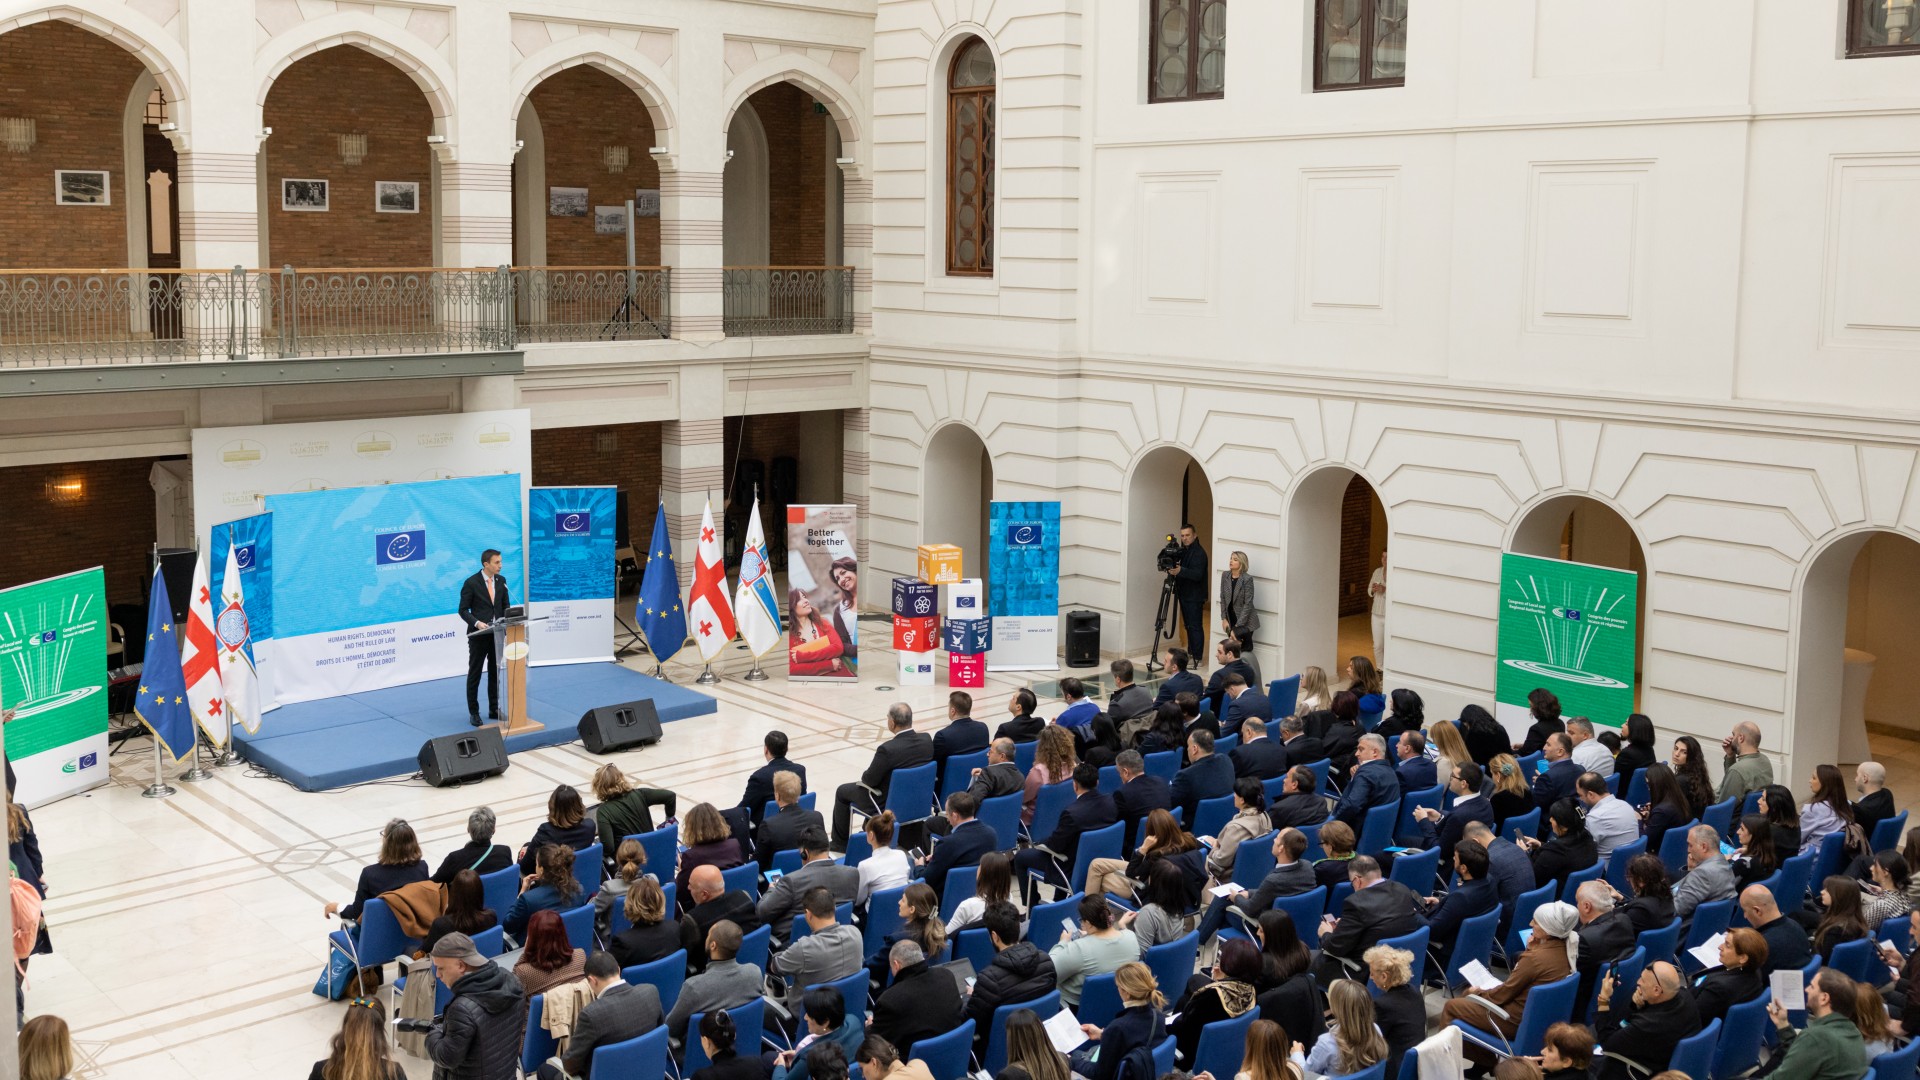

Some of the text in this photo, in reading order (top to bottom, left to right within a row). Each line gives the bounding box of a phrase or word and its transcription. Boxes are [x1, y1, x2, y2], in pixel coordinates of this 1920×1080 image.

[808, 529, 835, 537] Better
[808, 538, 845, 548] together
[908, 586, 915, 594] 17
[895, 618, 900, 626] 5
[328, 628, 396, 644] HUMAN RIGHTS, DEMOCRACY
[411, 631, 456, 643] www.coe.int
[355, 641, 364, 649] THE
[365, 640, 378, 648] RULE
[385, 637, 396, 645] LAW
[316, 658, 334, 667] DROITS
[367, 648, 396, 660] DÉMOCRATIE
[357, 662, 363, 670] ET
[382, 656, 396, 665] DROIT
[951, 655, 959, 663] 10
